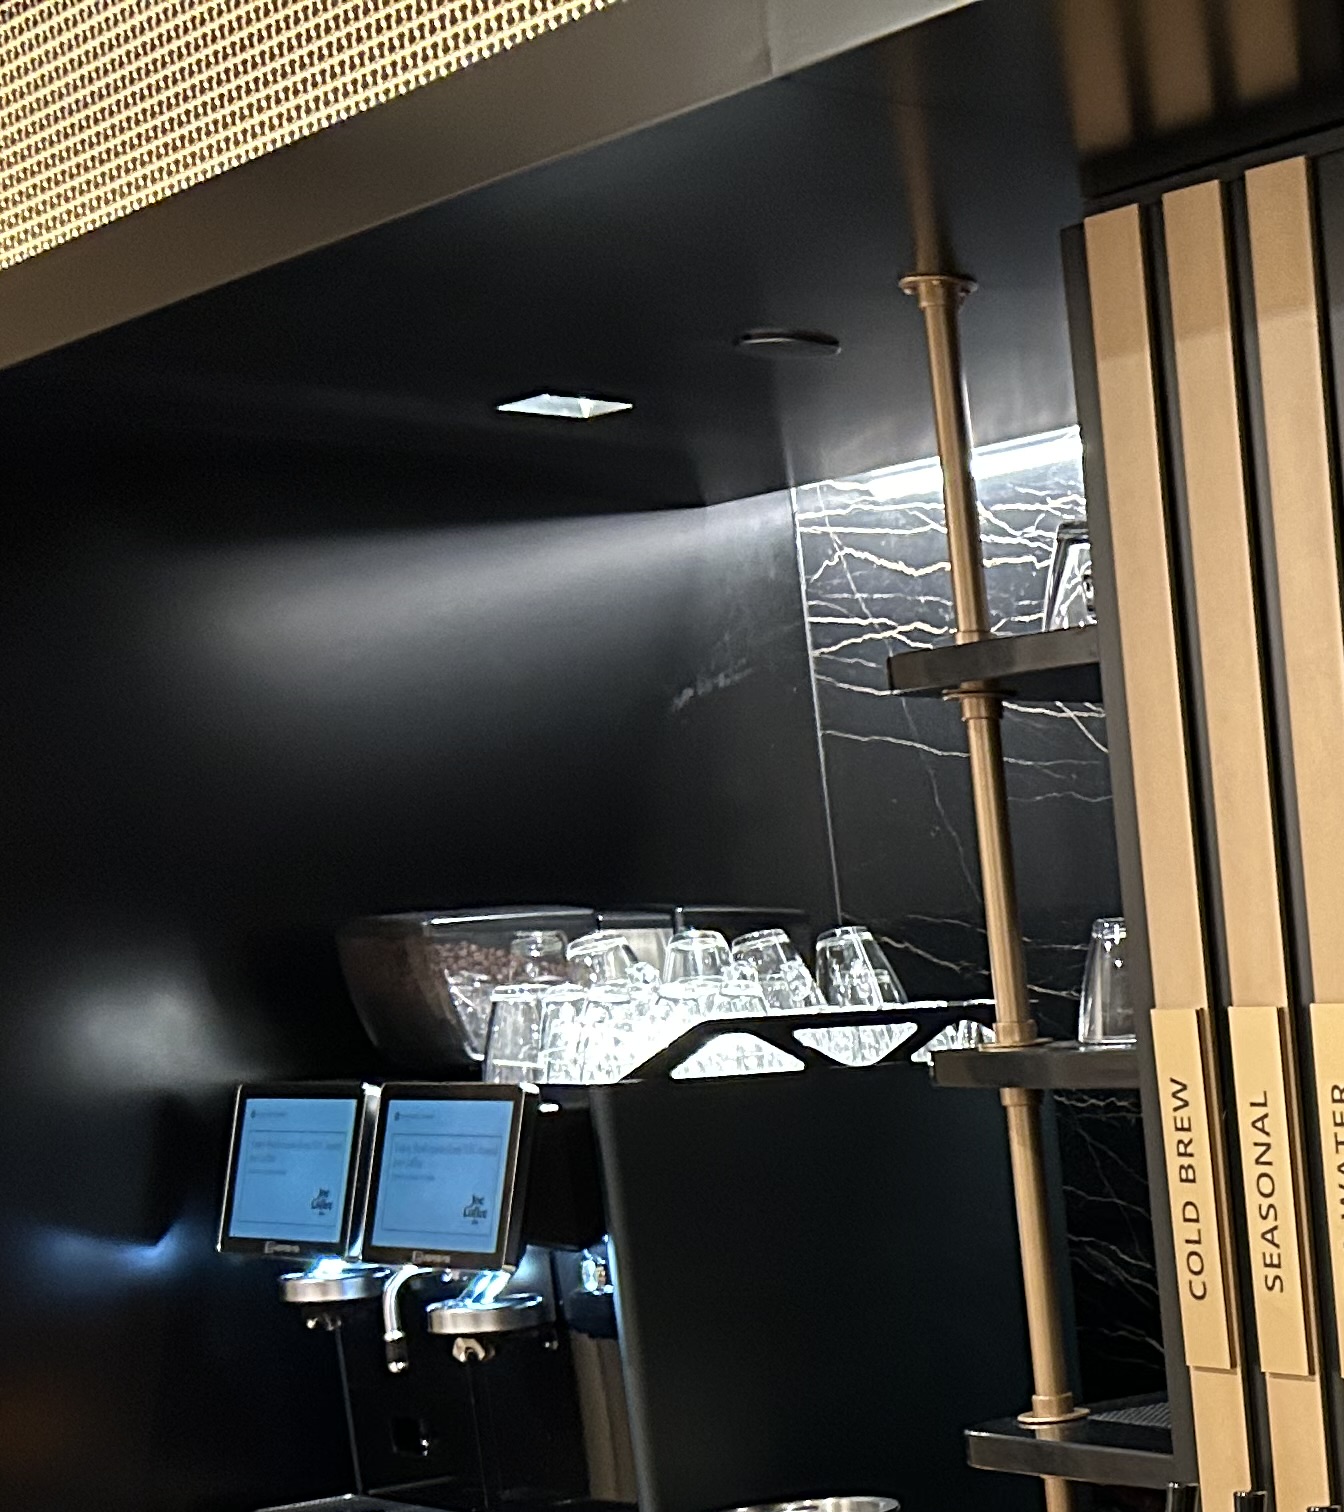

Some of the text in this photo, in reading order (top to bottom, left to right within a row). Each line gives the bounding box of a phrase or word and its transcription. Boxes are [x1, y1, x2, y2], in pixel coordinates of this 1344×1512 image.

[1169, 1077, 1207, 1301] COLD BREW
[1249, 1090, 1284, 1293] SEASONAL
